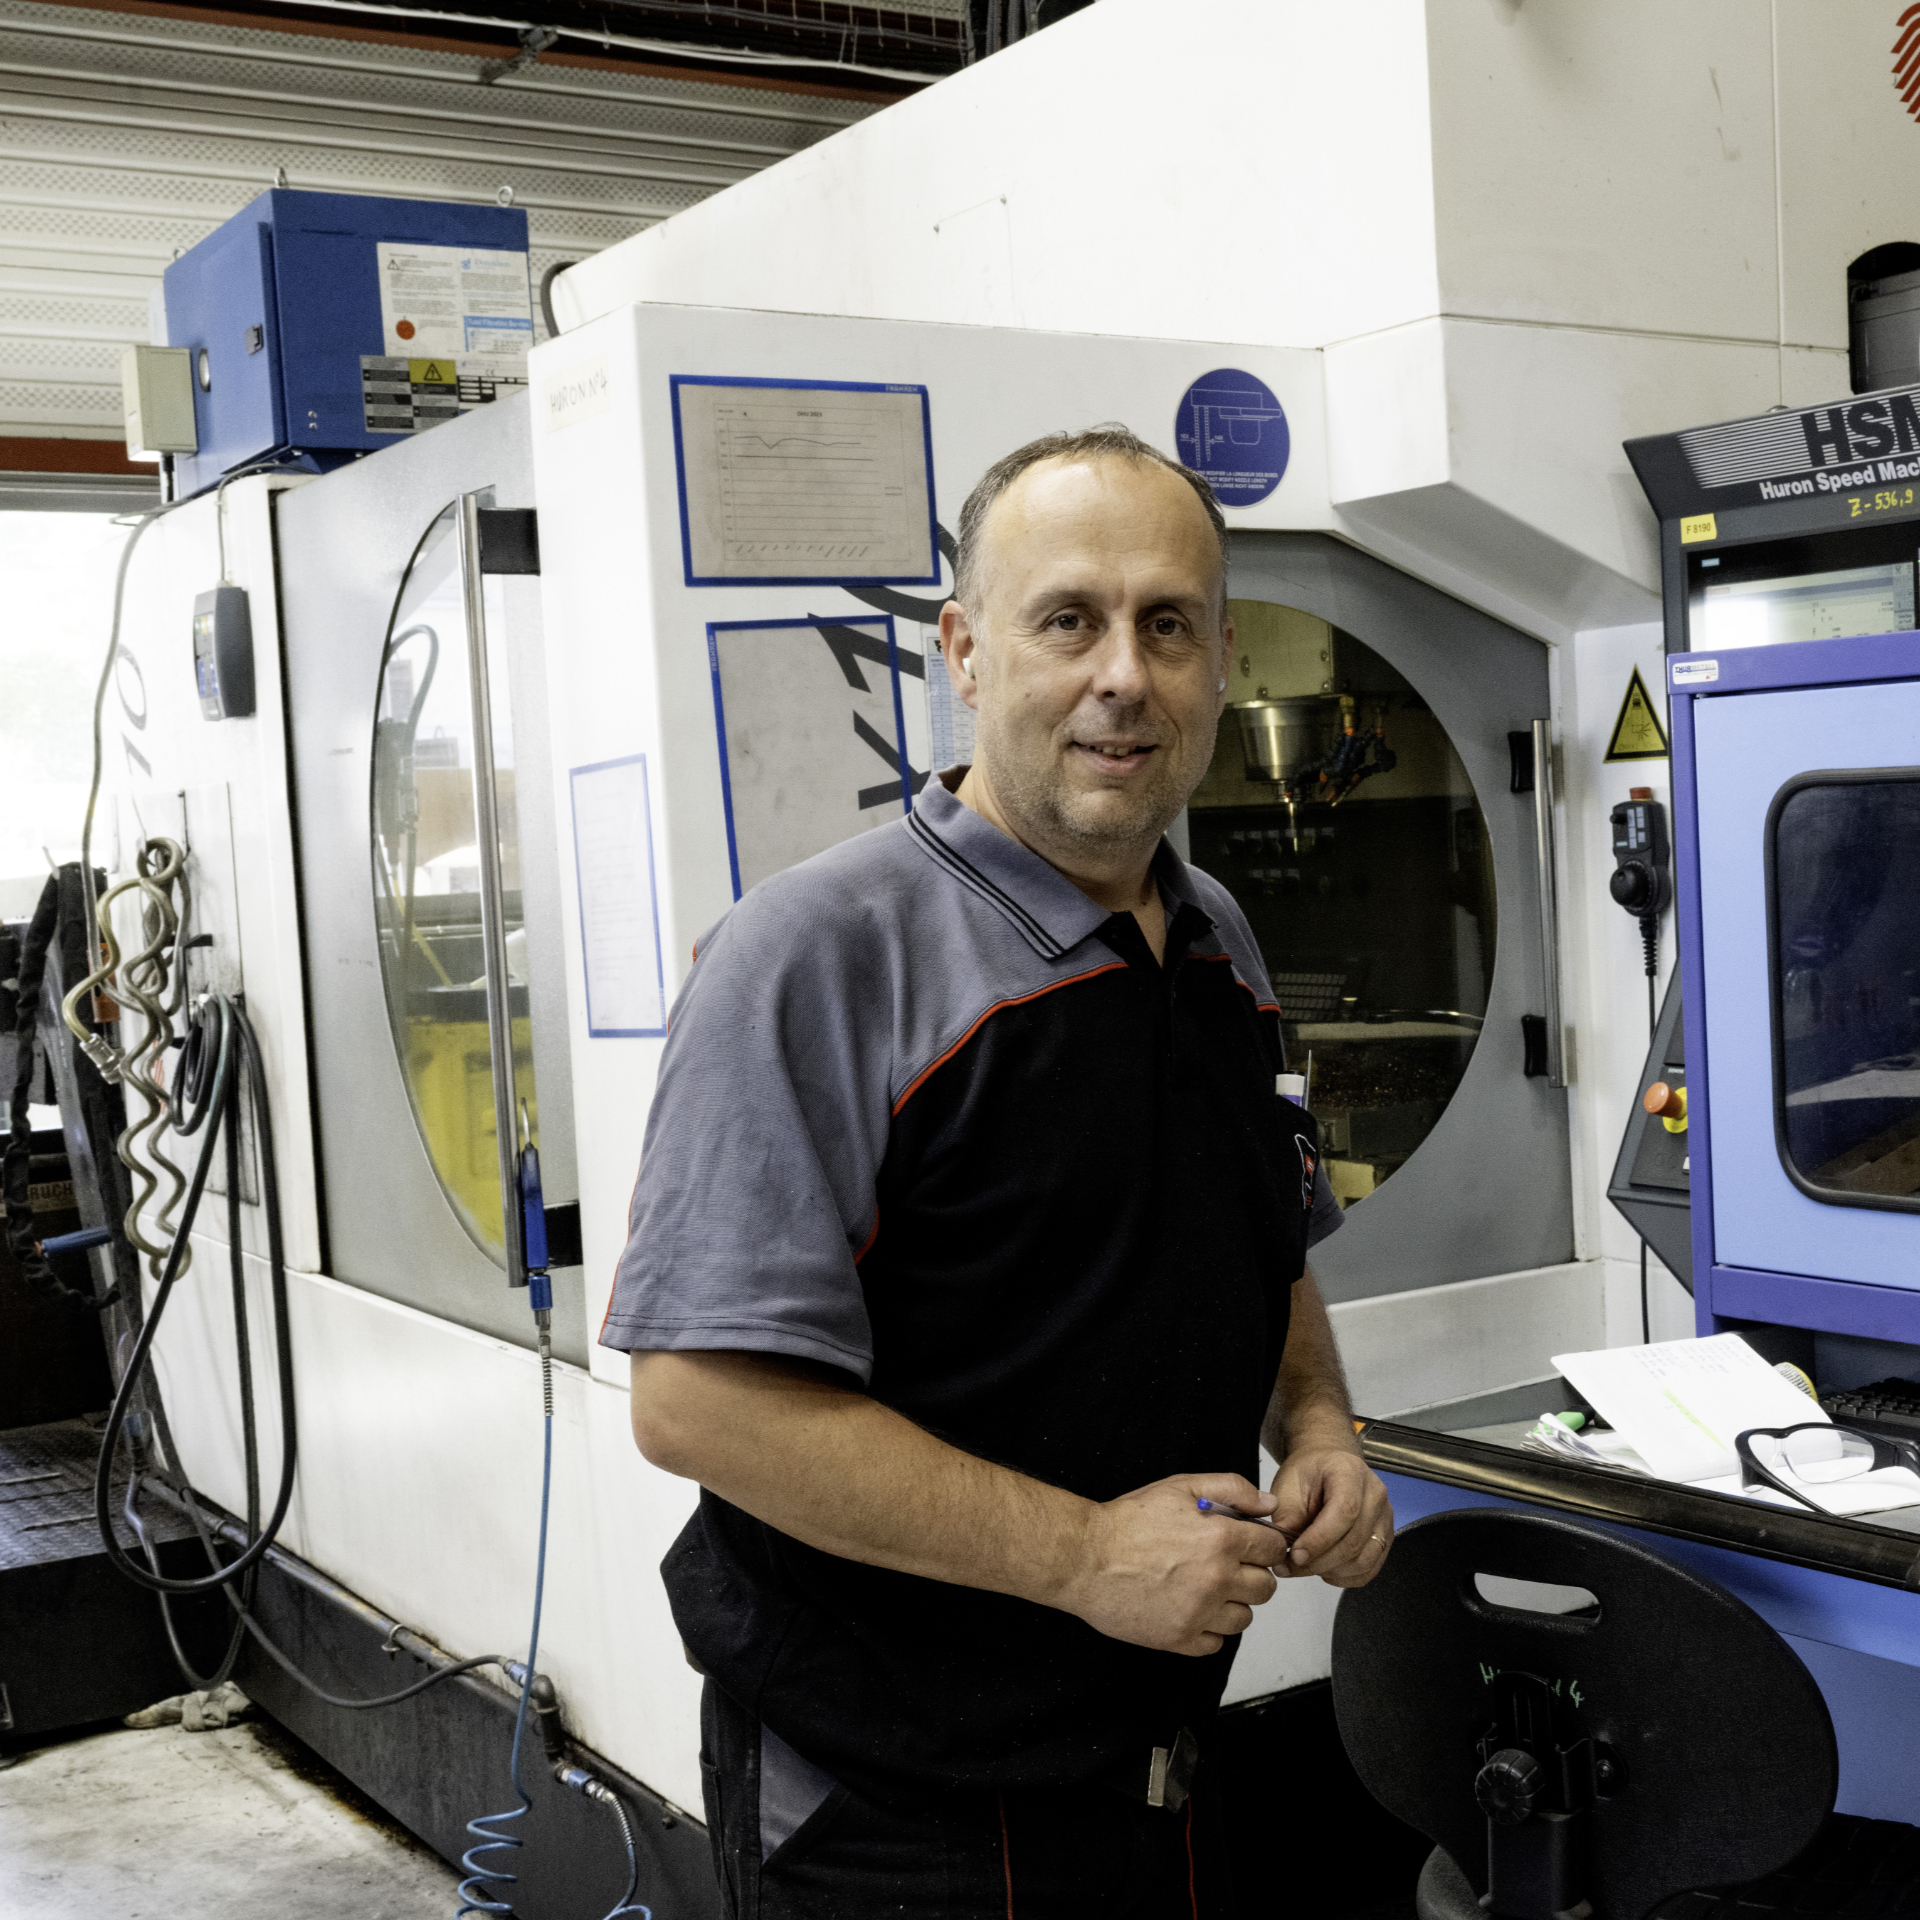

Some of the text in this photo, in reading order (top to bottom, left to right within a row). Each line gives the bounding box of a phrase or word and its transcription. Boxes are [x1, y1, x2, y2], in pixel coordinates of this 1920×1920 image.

[550, 380, 587, 414] HURON
[1759, 479, 1814, 500] Huron
[1815, 464, 1876, 493] Speed
[1693, 522, 1711, 533] 8190
